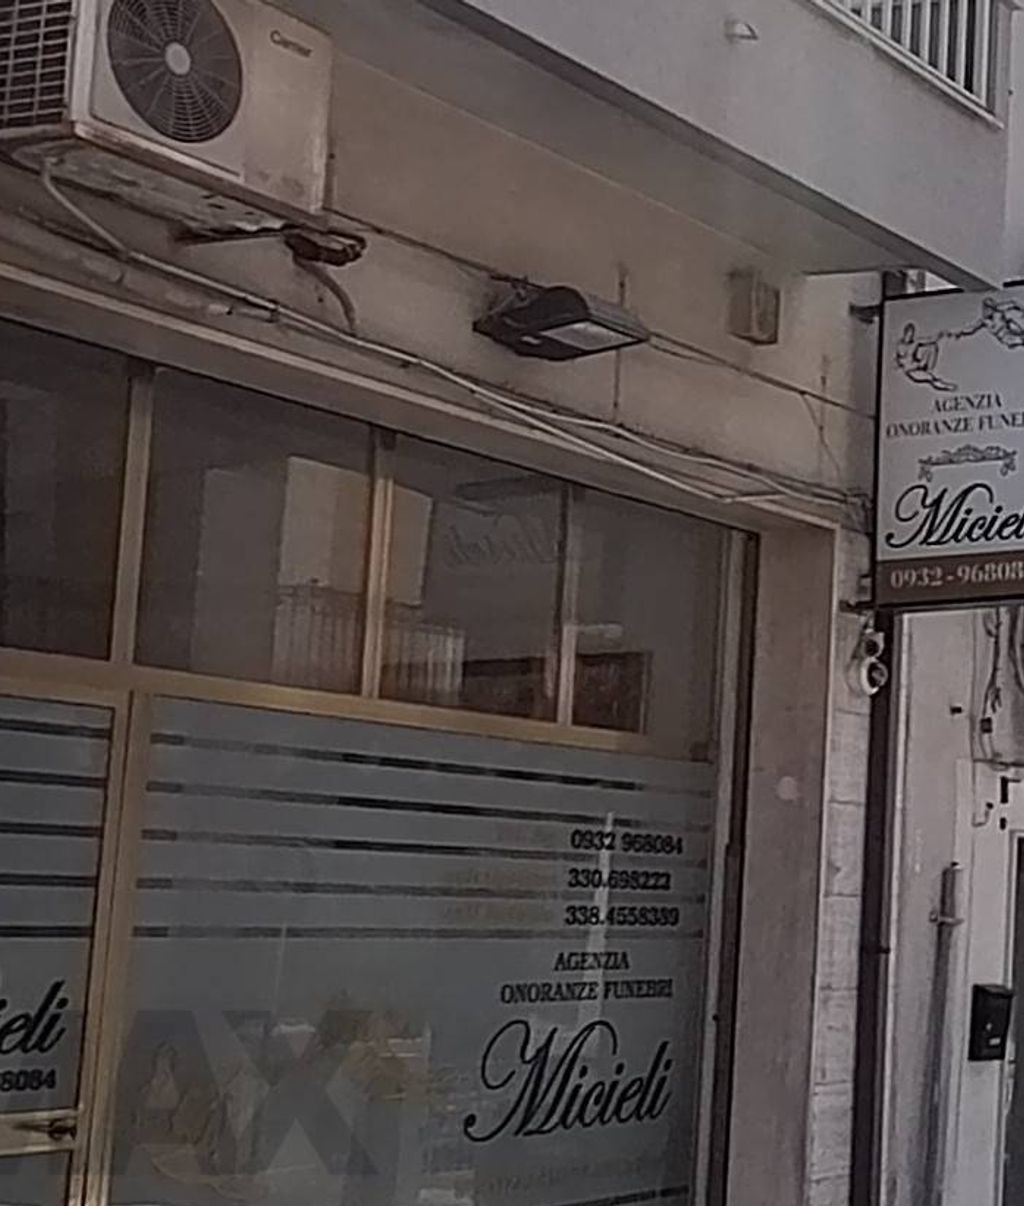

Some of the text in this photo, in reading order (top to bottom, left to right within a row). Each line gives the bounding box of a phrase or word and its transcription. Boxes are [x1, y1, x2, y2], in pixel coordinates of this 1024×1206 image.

[932, 393, 1002, 413] AGENZIA
[886, 416, 975, 438] ONORANZE
[570, 830, 615, 852] 0932
[553, 951, 630, 972] AGENZIA
[500, 978, 673, 1003] ONORANZE FUNEBRI
[463, 1019, 673, 1142] Micieli
